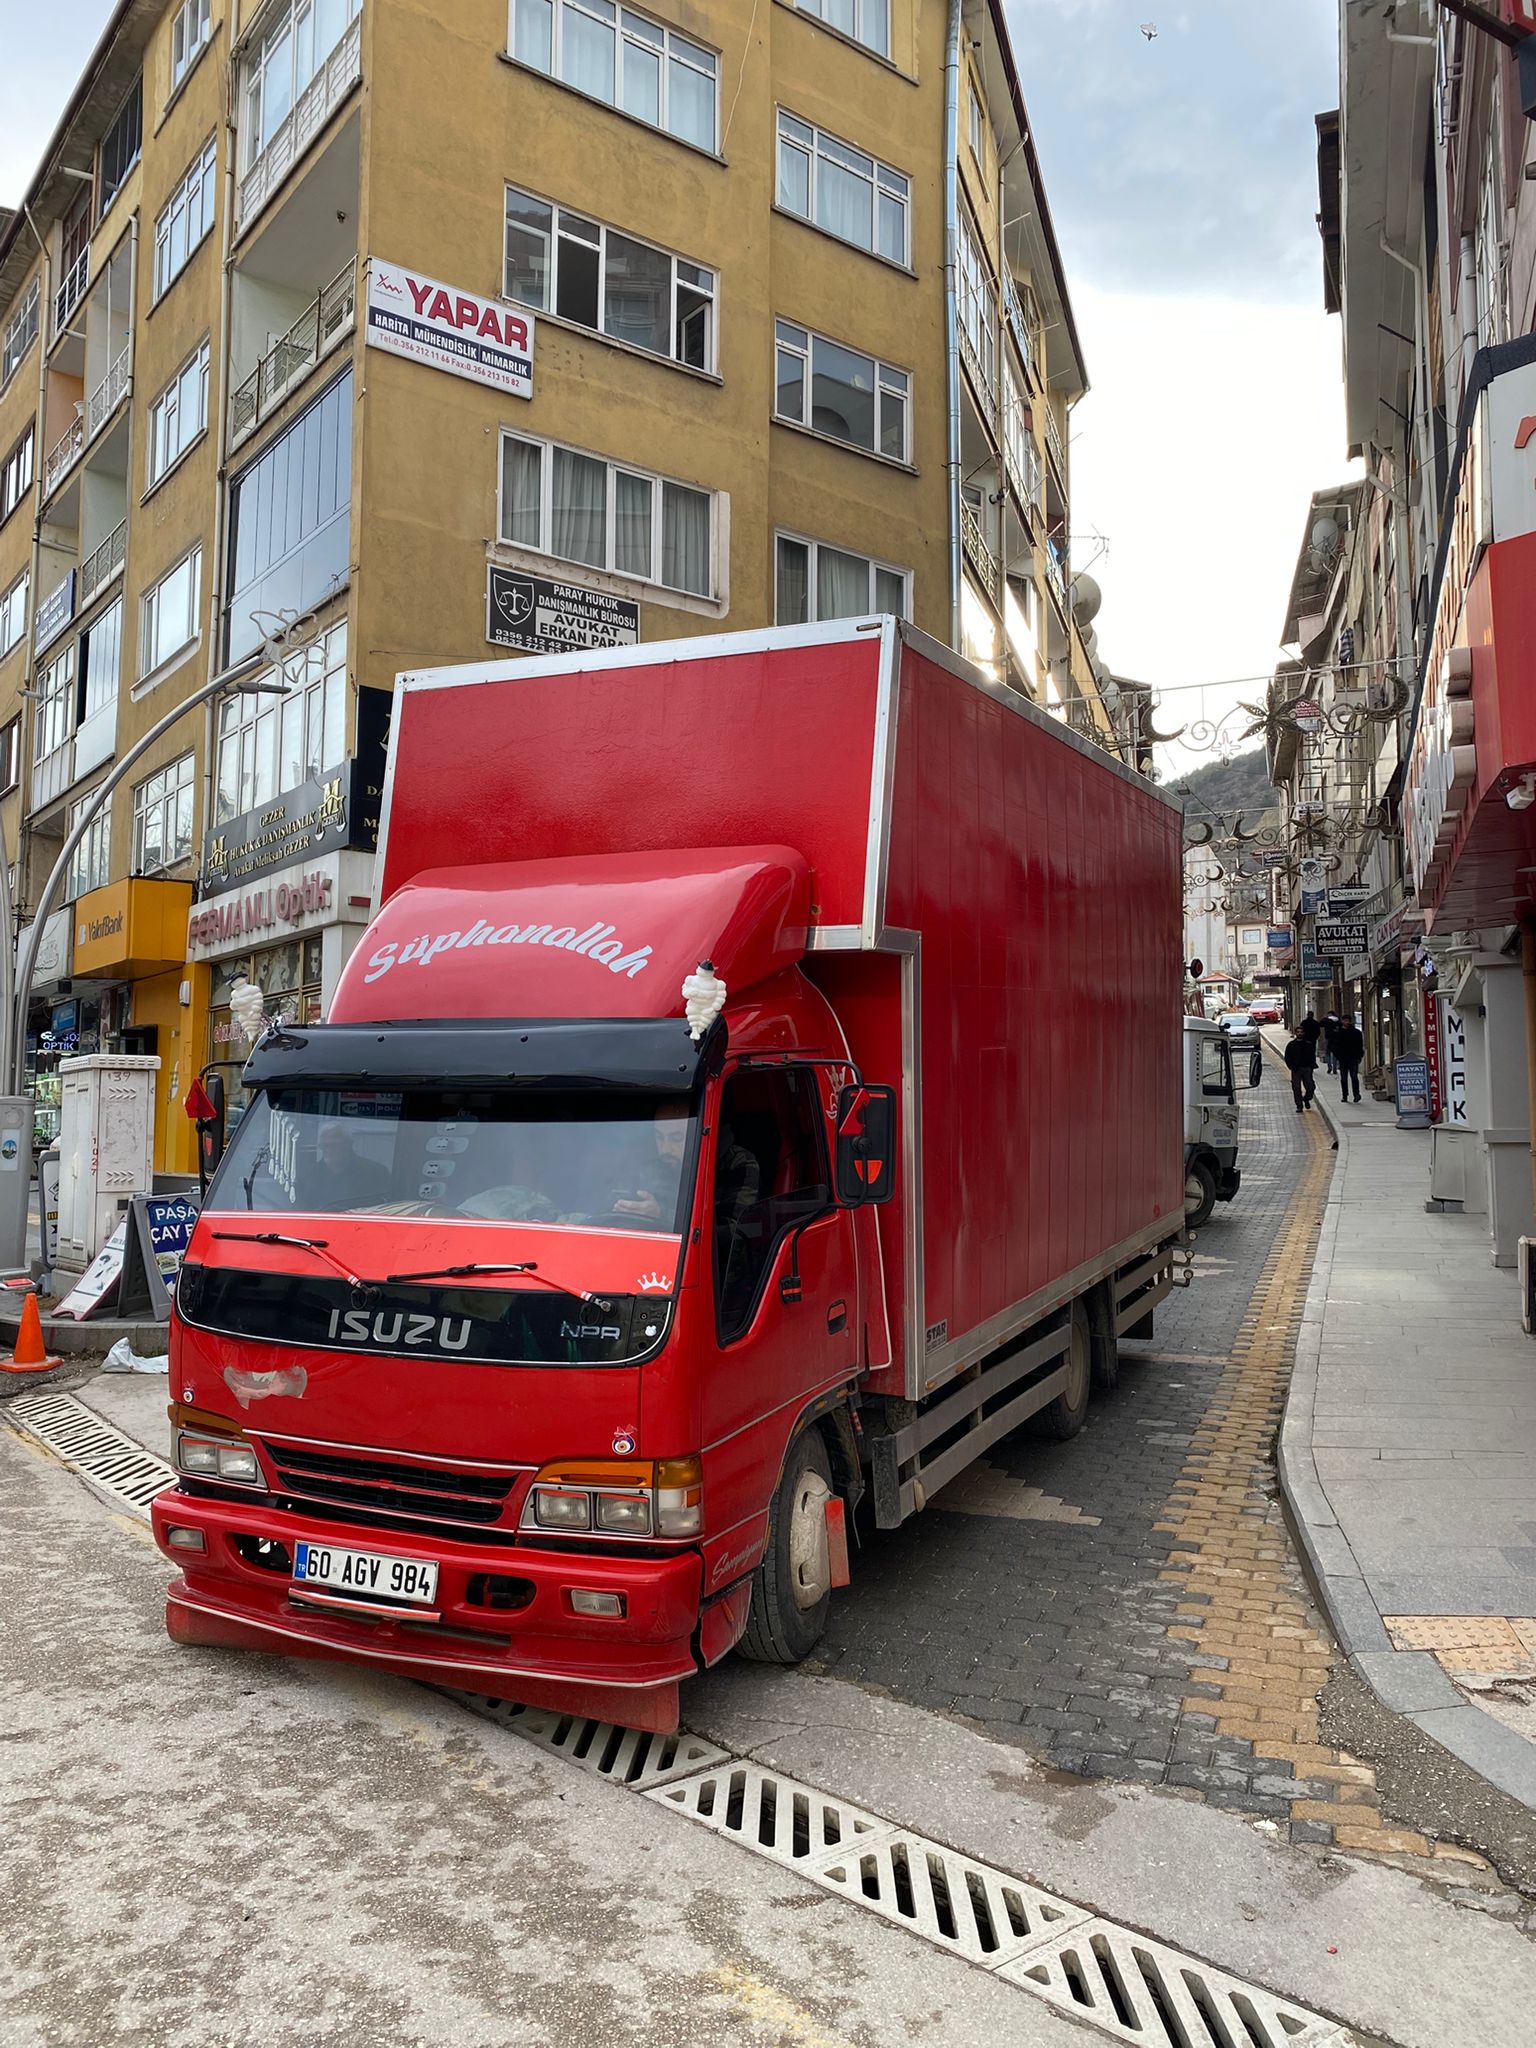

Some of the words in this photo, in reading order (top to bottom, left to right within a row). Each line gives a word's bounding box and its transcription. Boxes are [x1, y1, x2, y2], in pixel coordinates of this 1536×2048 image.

[405, 277, 528, 352] YAPAR
[375, 313, 409, 335] HARİTA
[414, 327, 477, 359] MÜHENDİSLİK
[481, 350, 528, 376] MİMARLIK
[415, 346, 430, 357] 212
[430, 351, 439, 360] 11
[487, 370, 500, 381] 213
[502, 375, 510, 384] 15
[511, 378, 520, 387] 82
[553, 585, 584, 600] PARAY
[585, 593, 619, 611] HUKUK
[538, 594, 599, 620] DANIŞMANLIK
[601, 609, 636, 629] BÜROSU
[495, 628, 523, 640] 0356
[525, 635, 546, 645] 212
[548, 641, 562, 649] 42
[540, 622, 587, 646] ERKAN
[553, 614, 620, 638] AVUKAT
[259, 805, 286, 828] GEZER
[230, 843, 254, 862] HUKUK
[262, 810, 316, 847] DANIŞMANLIK
[233, 860, 254, 878] Avukat
[283, 835, 311, 856] GEZER
[1317, 926, 1366, 938] AVUKAT
[1346, 937, 1366, 945] TOPAL
[364, 919, 653, 983] Süphanallah
[1448, 1000, 1467, 1120] MLAK
[155, 1205, 198, 1222] PAŞA
[150, 1225, 180, 1244] ÇAY
[327, 1308, 472, 1350] ISUZU
[560, 1320, 622, 1341] NPR
[926, 1321, 946, 1343] STAR
[298, 1563, 306, 1573] TR
[307, 1549, 331, 1579] 60
[341, 1555, 381, 1588] AGV
[390, 1563, 430, 1596] 984
